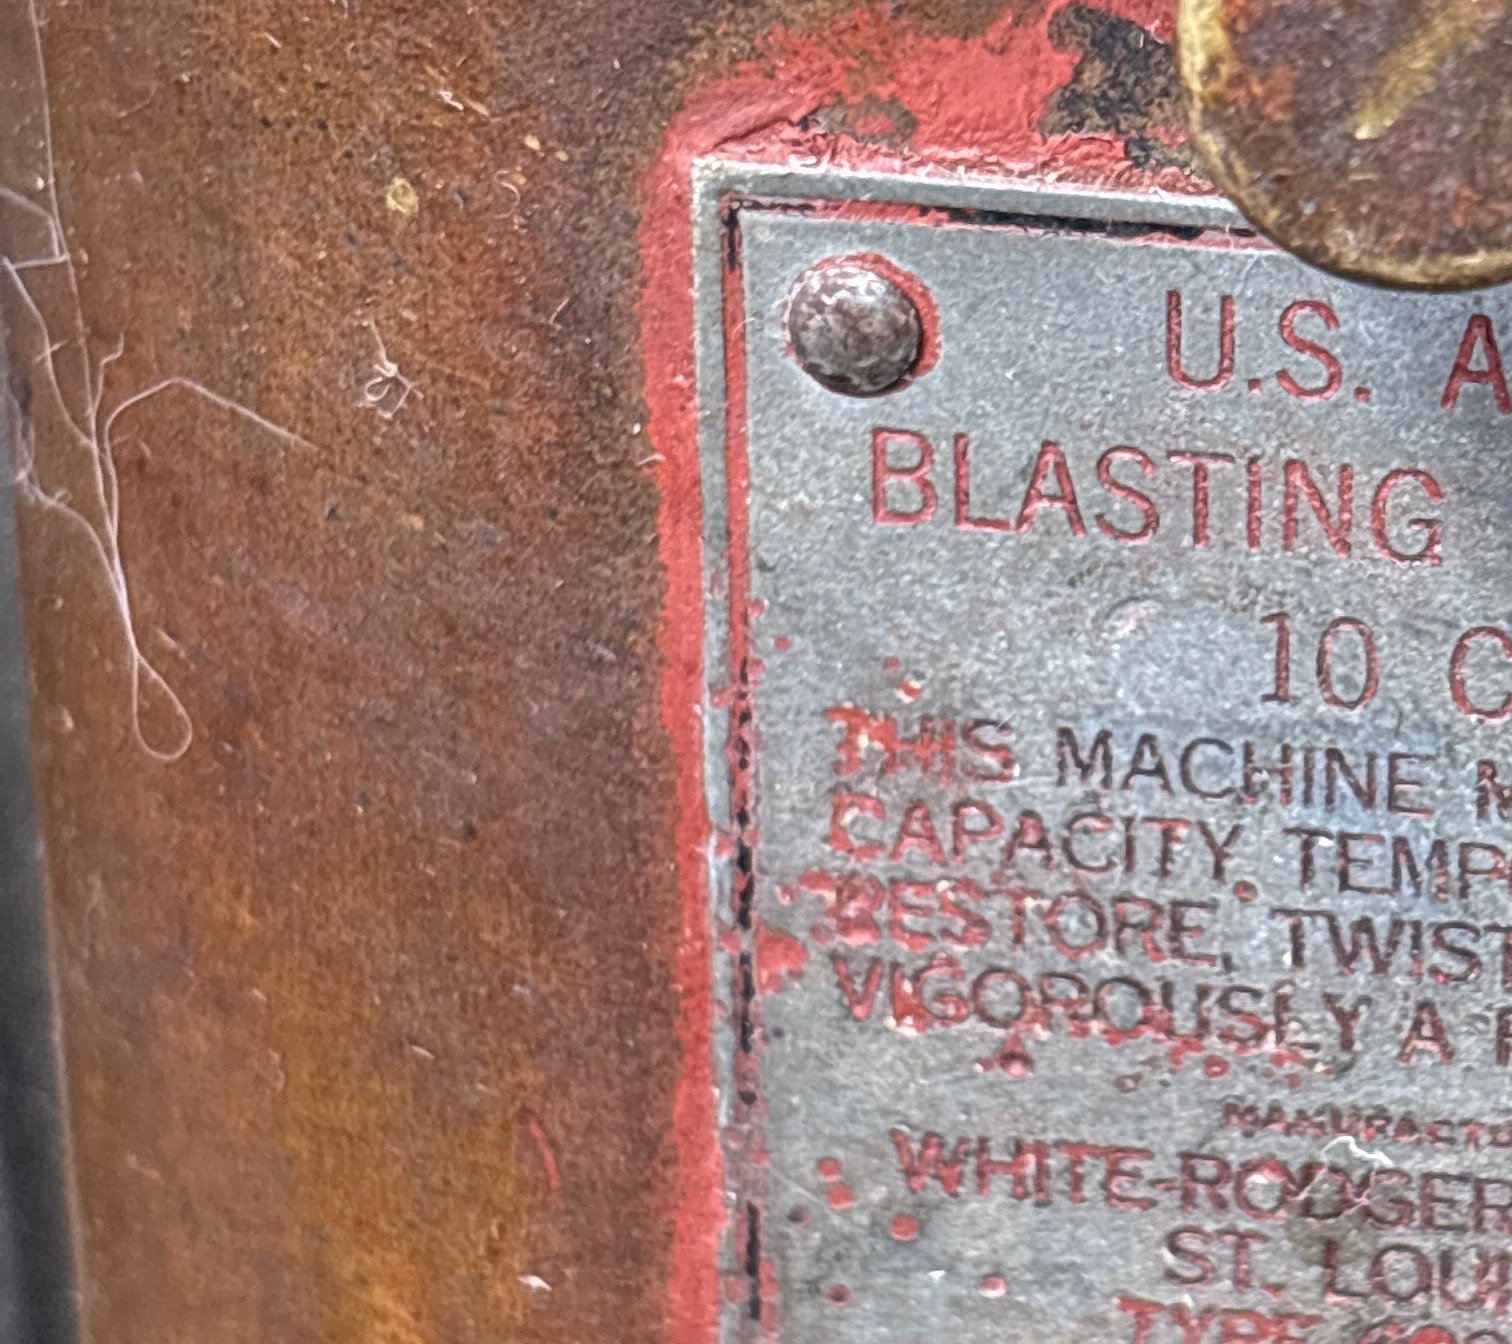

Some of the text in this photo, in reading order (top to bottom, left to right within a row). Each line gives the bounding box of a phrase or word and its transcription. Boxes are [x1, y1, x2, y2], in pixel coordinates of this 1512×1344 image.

[1165, 289, 1371, 403] U.S.
[871, 427, 1443, 566] BLASTING
[1260, 611, 1380, 711] 10
[824, 706, 1019, 782] THIS
[1056, 726, 1435, 818] MACHINE
[832, 950, 1373, 1055] VIGOROUSLY
[1400, 1000, 1453, 1066] A
